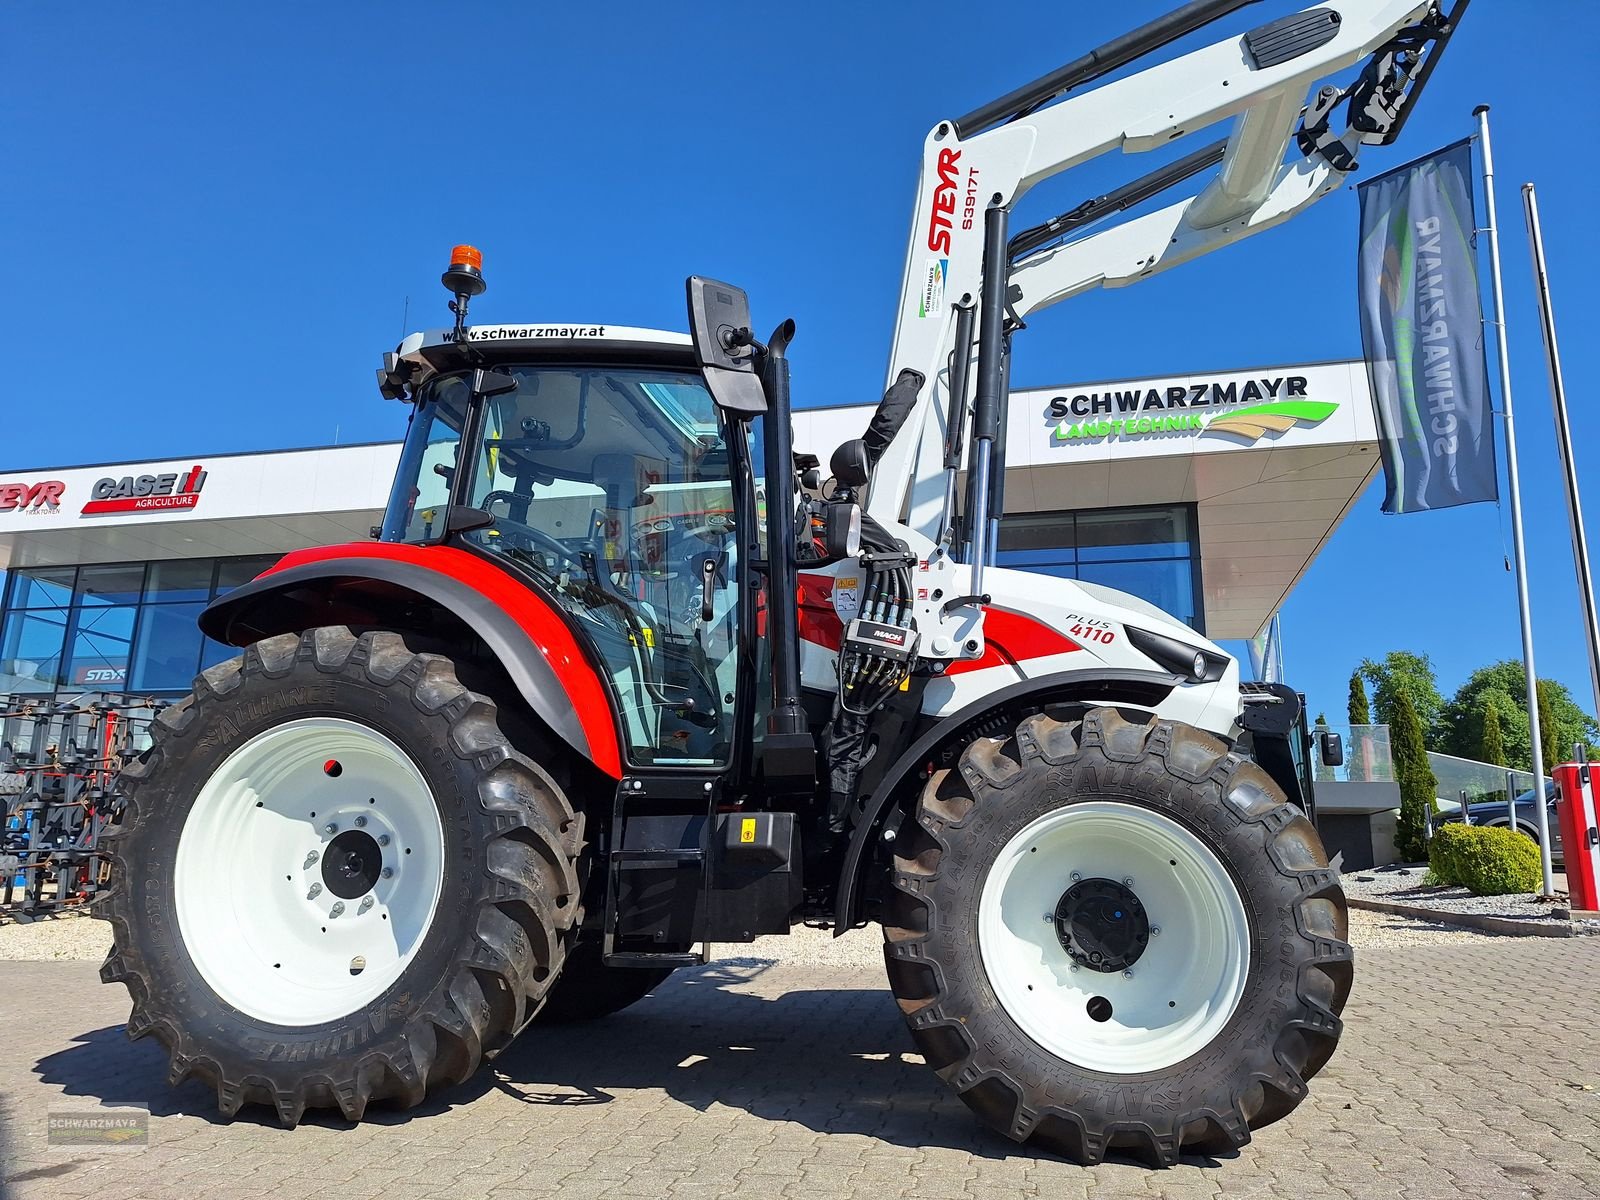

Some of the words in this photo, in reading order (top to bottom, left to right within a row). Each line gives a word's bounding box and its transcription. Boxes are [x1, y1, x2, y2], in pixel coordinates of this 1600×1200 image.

[928, 147, 962, 257] STEYR
[962, 167, 980, 230] S3917T
[924, 267, 935, 313] SCHWARZMAYR
[442, 326, 605, 342] ww.schwarzmayr.at
[1050, 376, 1308, 418] SCHWARZMAYR
[1056, 415, 1203, 440] LANDTECHNIK
[91, 474, 177, 499] CASE
[135, 495, 193, 508] AGRICULTURE
[1065, 613, 1112, 629] PLUS
[1069, 623, 1115, 644] 4110
[873, 630, 903, 641] MACH
